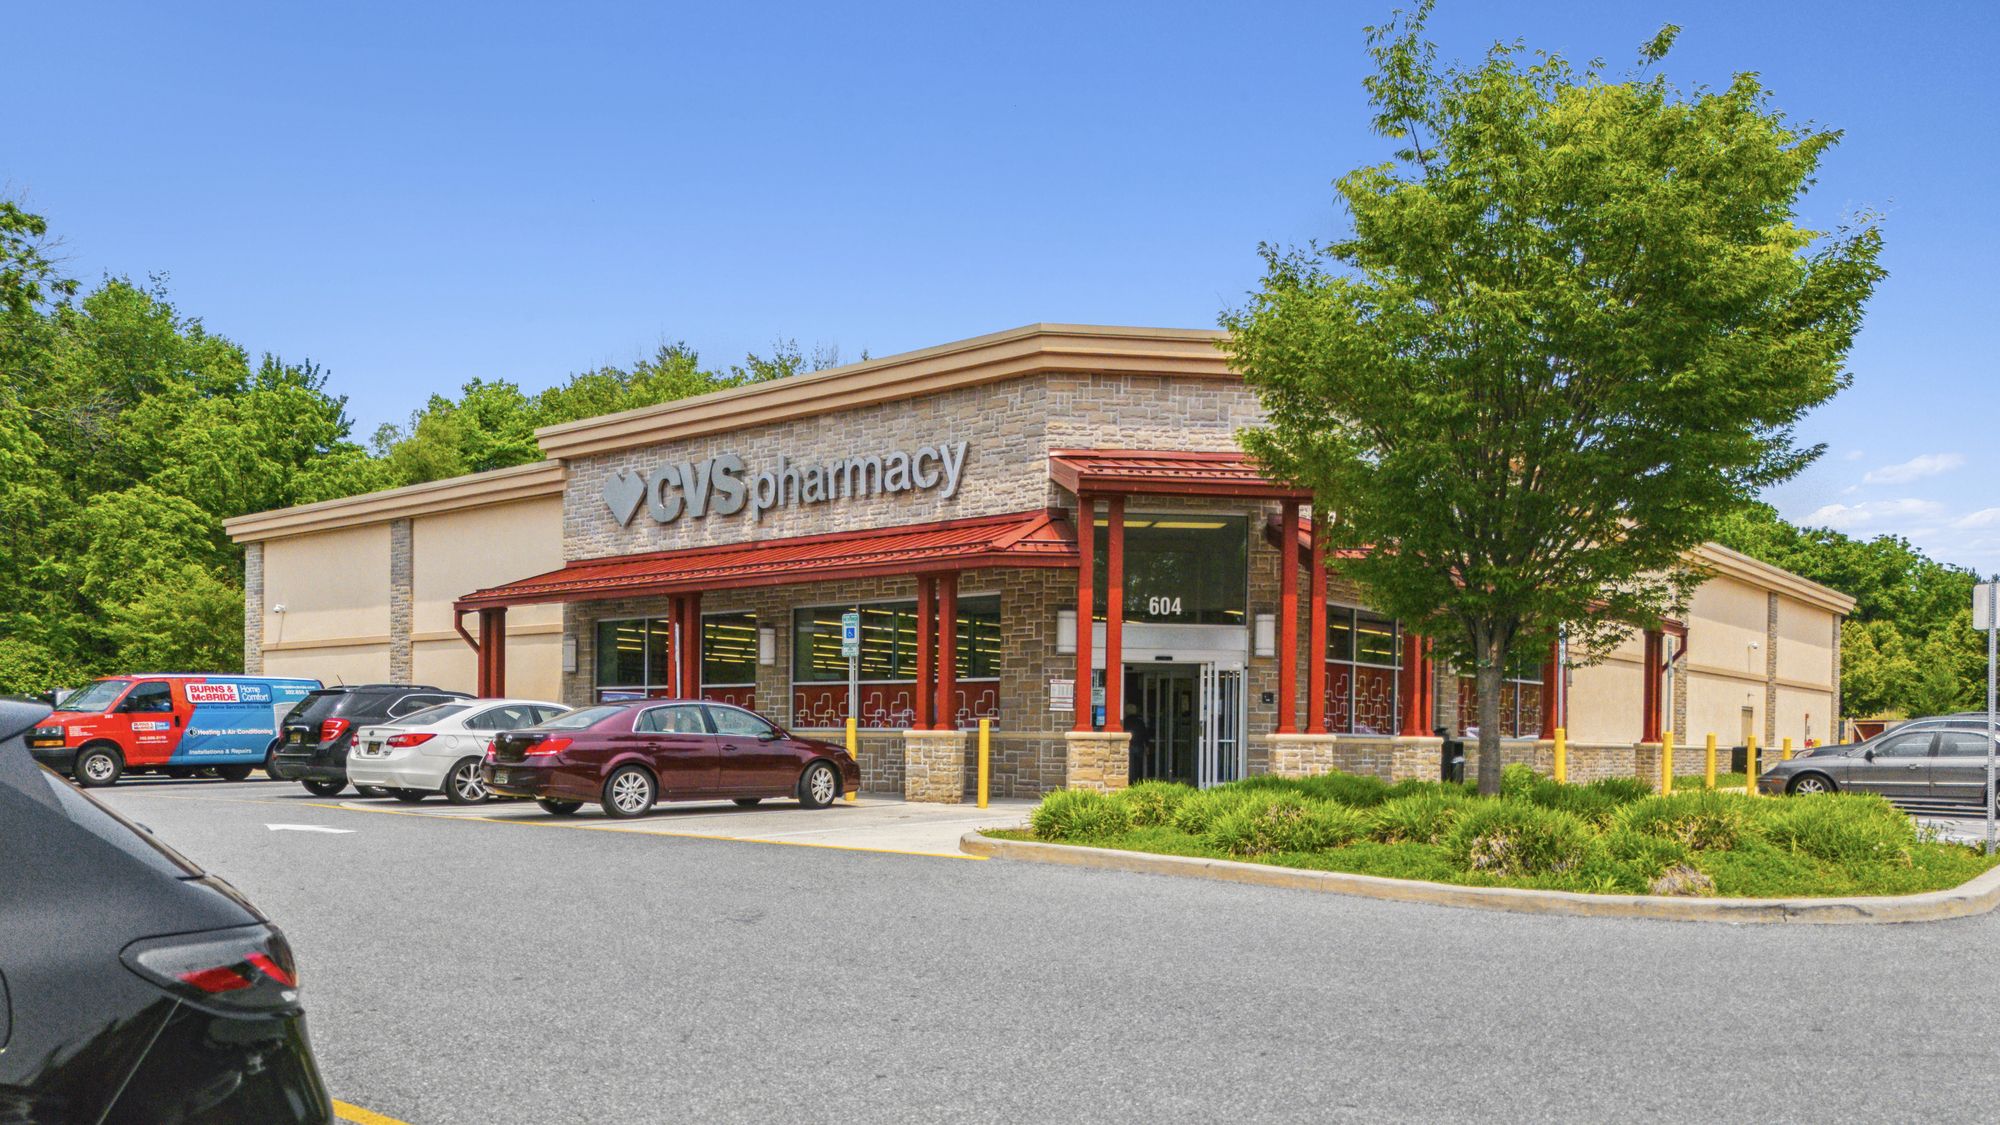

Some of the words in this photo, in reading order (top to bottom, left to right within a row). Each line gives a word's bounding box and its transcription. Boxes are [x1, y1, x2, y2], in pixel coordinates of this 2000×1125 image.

[649, 452, 748, 523] CVS
[752, 440, 969, 522] pharmacy
[1149, 597, 1181, 615] 604
[189, 685, 225, 693] BURNS
[227, 685, 234, 693] &
[240, 685, 260, 693] Home
[191, 693, 237, 701] McBRIDE
[241, 693, 269, 701] Comfort
